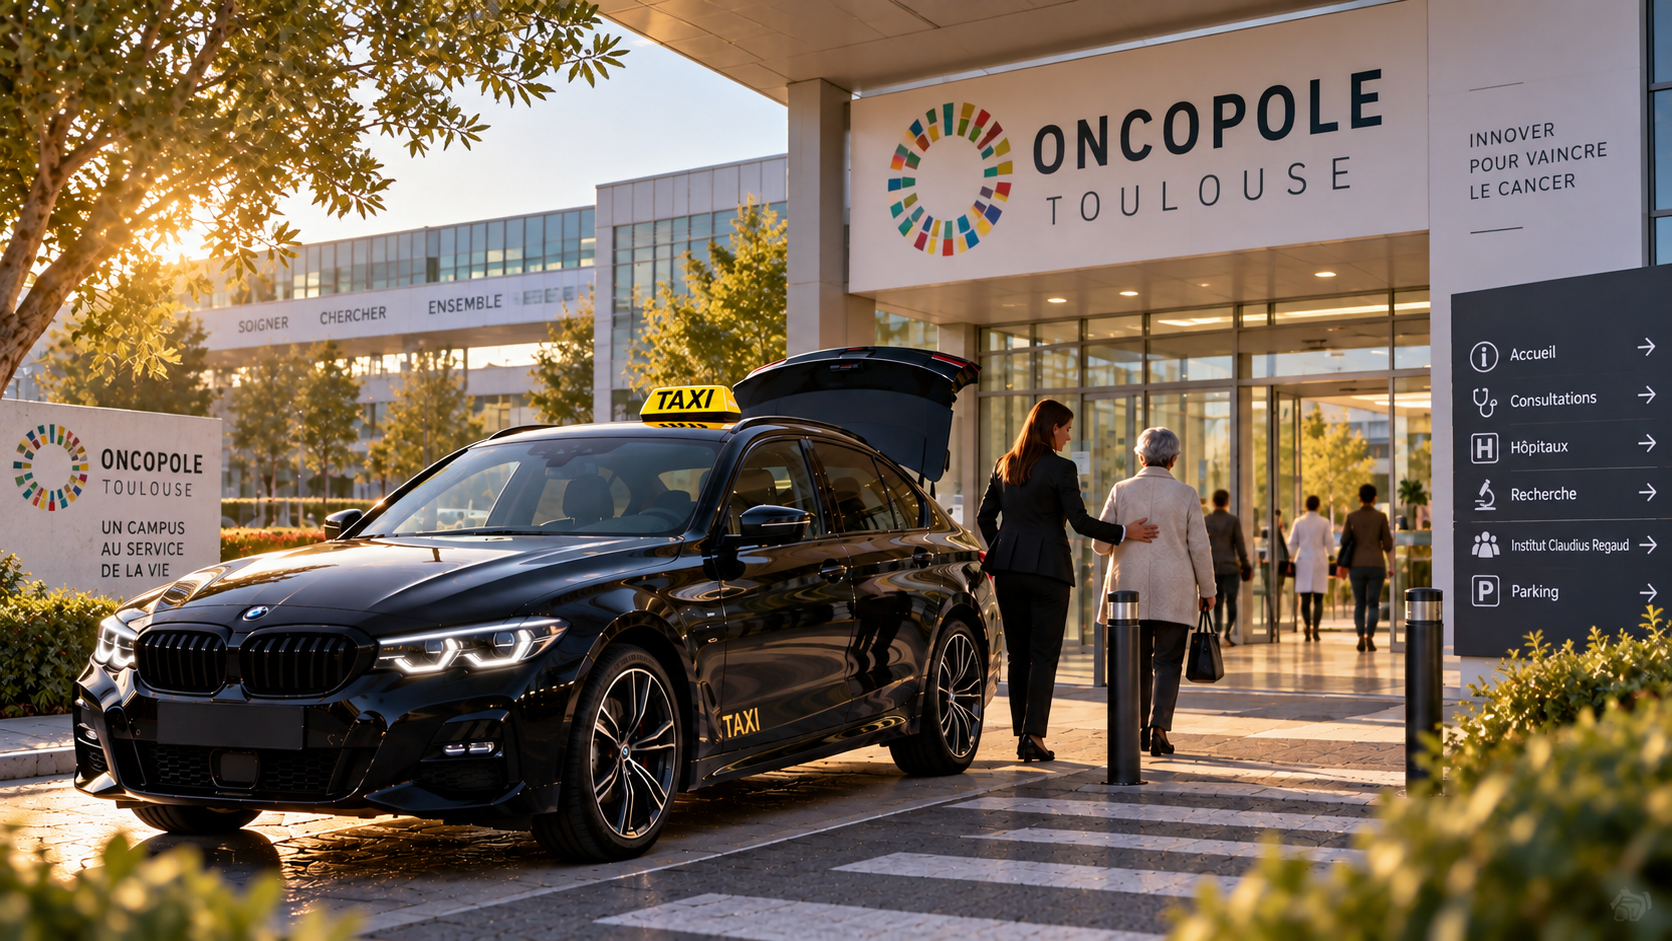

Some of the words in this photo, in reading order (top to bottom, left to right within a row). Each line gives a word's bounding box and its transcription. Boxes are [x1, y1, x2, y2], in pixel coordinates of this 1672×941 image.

[1032, 68, 1383, 175] ONCOPOLE
[1469, 122, 1555, 148] INNOVER
[1470, 153, 1519, 174] POUR
[1526, 141, 1608, 166] VAINCRE
[1046, 156, 1351, 226] TOULOUSE
[1470, 183, 1491, 200] LE
[1498, 173, 1576, 196] CANCER
[238, 316, 289, 333] SOIGNER
[319, 306, 387, 325] CHERCHER
[428, 294, 503, 315] ENSEMBLE
[1510, 345, 1556, 361] Accueil
[657, 388, 715, 410] TAXI
[1510, 391, 1597, 408] Consultations
[1511, 440, 1569, 457] Hôpitaux
[101, 448, 203, 474] ONCOPOLE
[102, 479, 192, 497] TOULOUSE
[1511, 486, 1577, 501] Recherche
[102, 521, 122, 534] UN
[127, 521, 185, 535] CAMPUS
[101, 542, 121, 556] AU
[127, 542, 184, 556] SERVICE
[1511, 539, 1547, 552] Institut
[1548, 539, 1590, 552] Claudius
[1592, 538, 1630, 555] Regaud
[101, 564, 120, 578] DE
[126, 564, 144, 578] LA
[148, 563, 170, 577] VIE
[1512, 584, 1559, 601] Parking
[722, 707, 760, 738] TAXI
